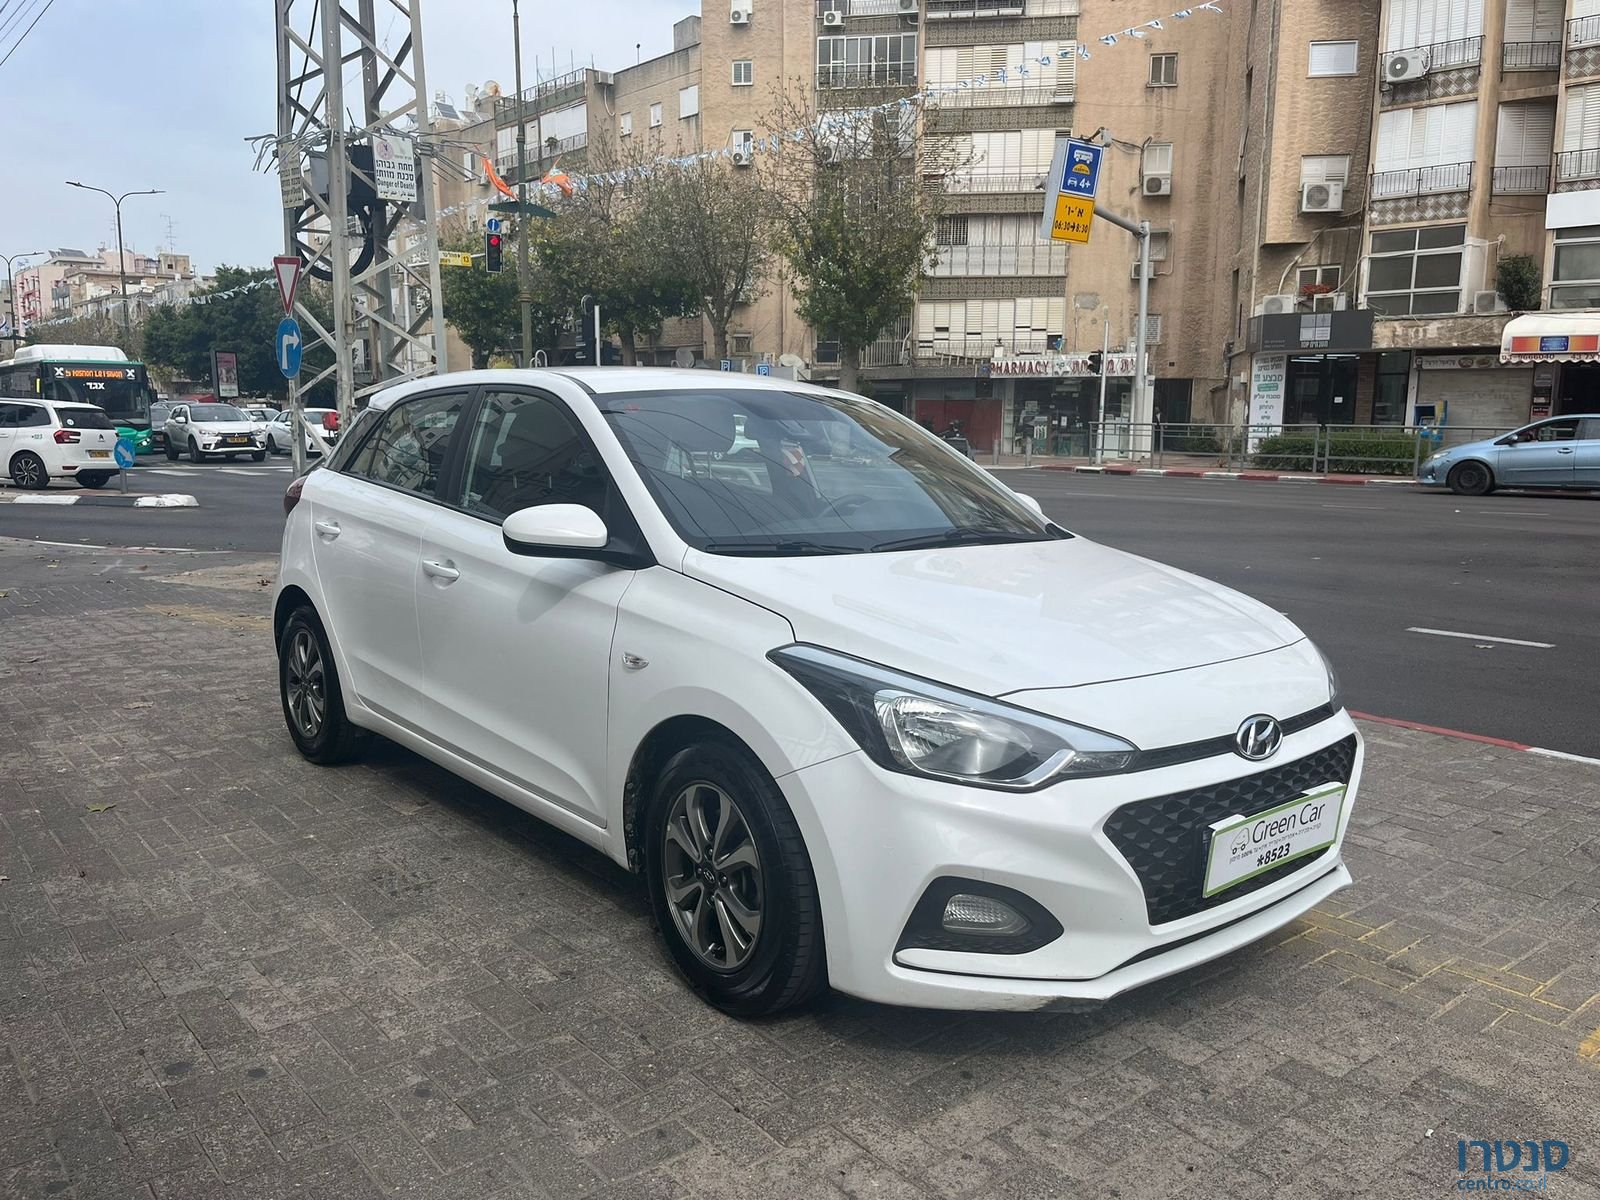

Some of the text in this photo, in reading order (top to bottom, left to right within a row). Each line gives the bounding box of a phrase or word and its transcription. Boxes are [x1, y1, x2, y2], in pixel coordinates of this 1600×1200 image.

[397, 172, 414, 181] סכנת
[1079, 178, 1091, 188] 4+
[990, 361, 1049, 376] PHARMACY
[1252, 803, 1325, 843] Green Car
